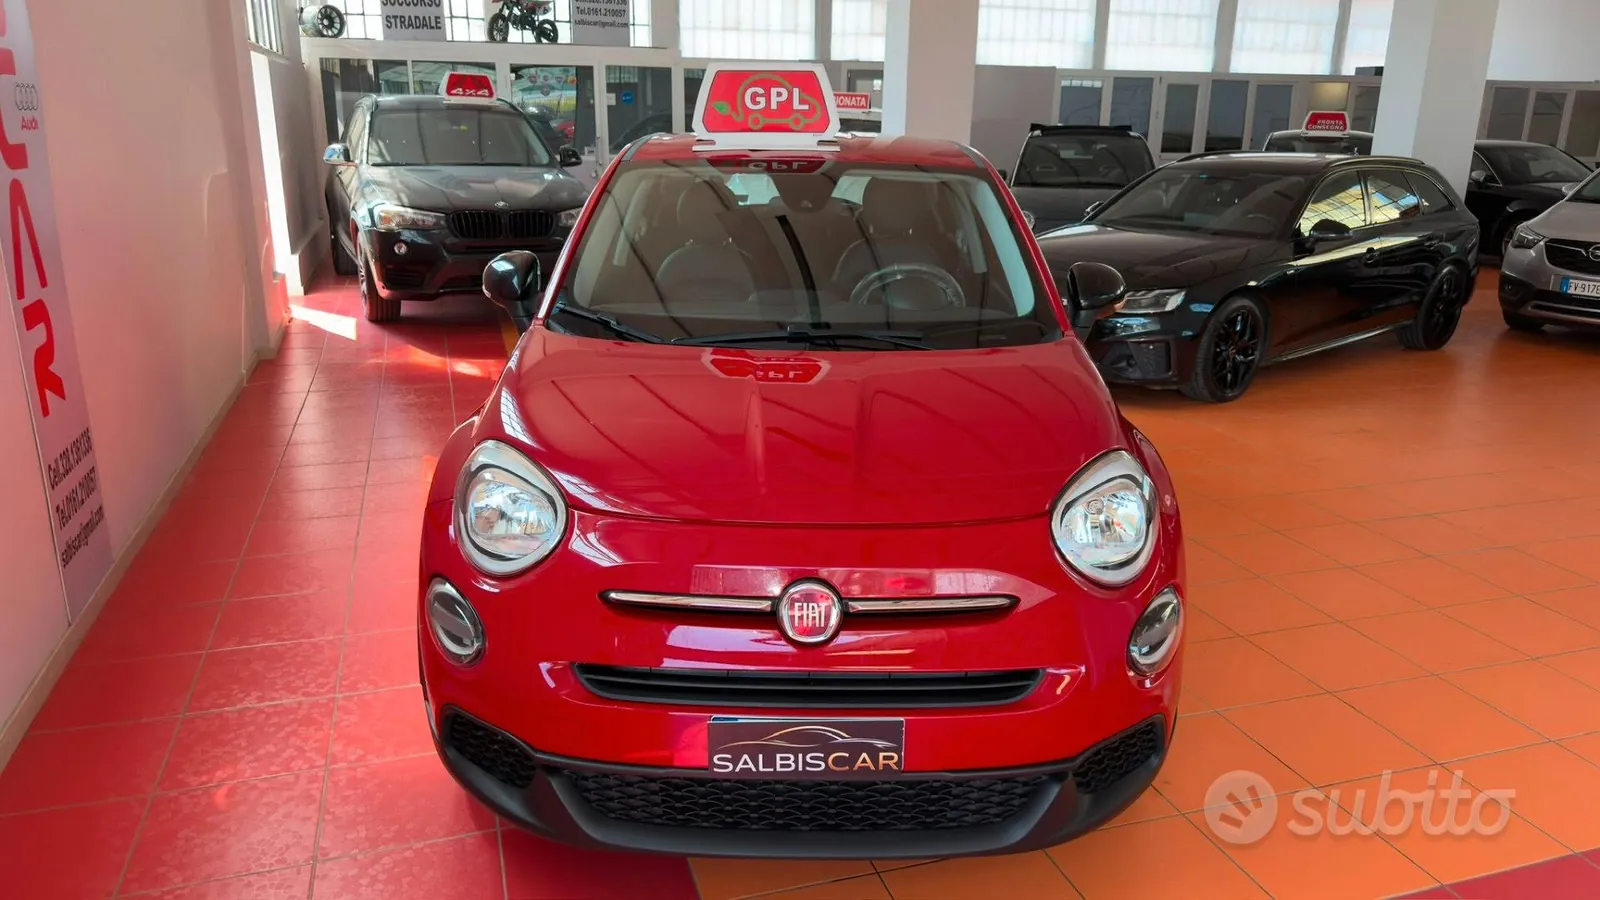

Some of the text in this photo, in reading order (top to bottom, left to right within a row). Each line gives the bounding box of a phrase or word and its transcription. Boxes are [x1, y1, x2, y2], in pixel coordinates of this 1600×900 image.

[385, 15, 442, 30] STRADALE
[744, 86, 811, 111] GPL
[835, 95, 867, 108] IONATA
[21, 116, 38, 130] Audi
[794, 602, 827, 628] FIAT
[712, 751, 900, 773] SALBISCAR
